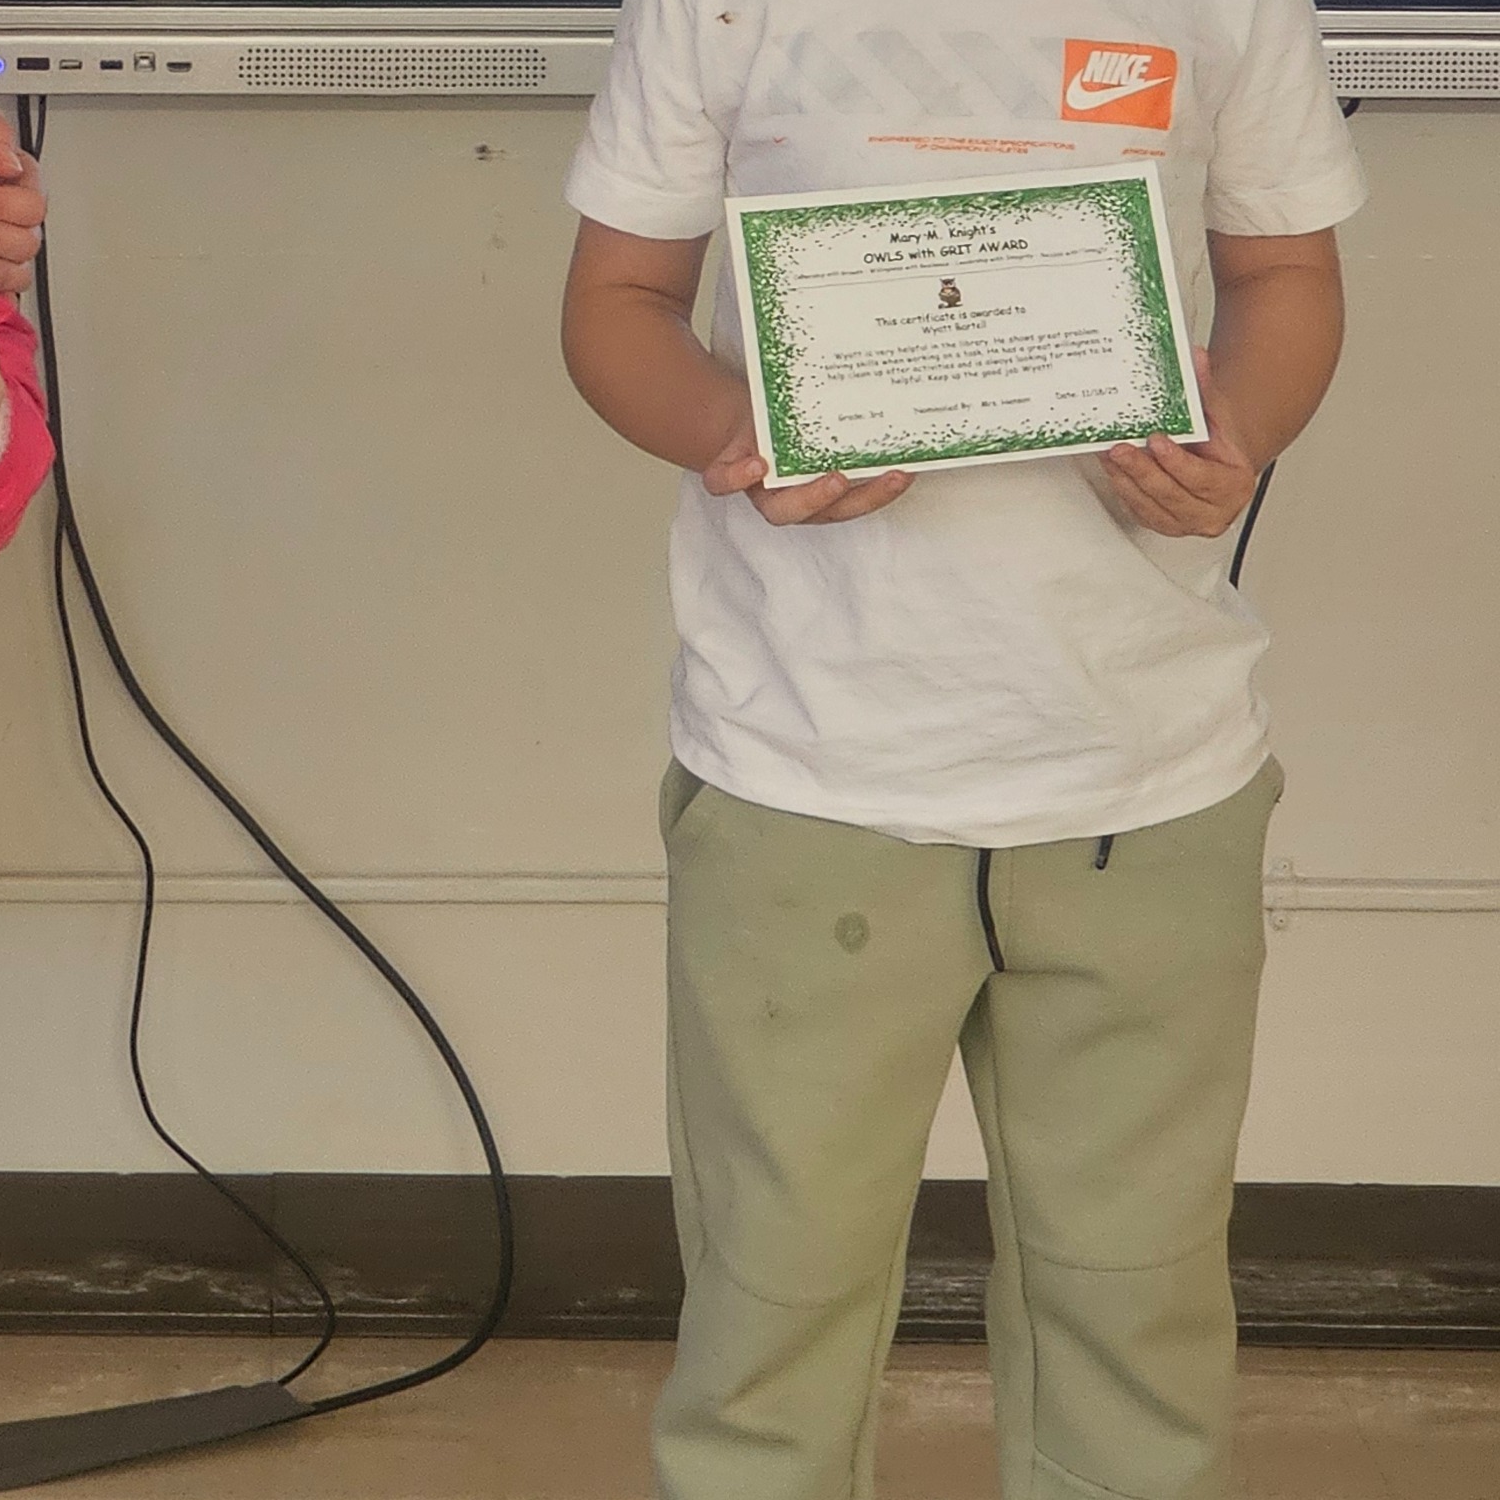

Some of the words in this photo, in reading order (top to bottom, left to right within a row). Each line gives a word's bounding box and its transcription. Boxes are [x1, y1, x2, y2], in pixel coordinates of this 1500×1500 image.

[1083, 50, 1150, 85] NIKE
[890, 232, 921, 244] Mary
[863, 250, 904, 264] OWLS
[909, 247, 935, 260] with
[940, 244, 972, 257] GRIT
[979, 239, 1029, 253] AWARD
